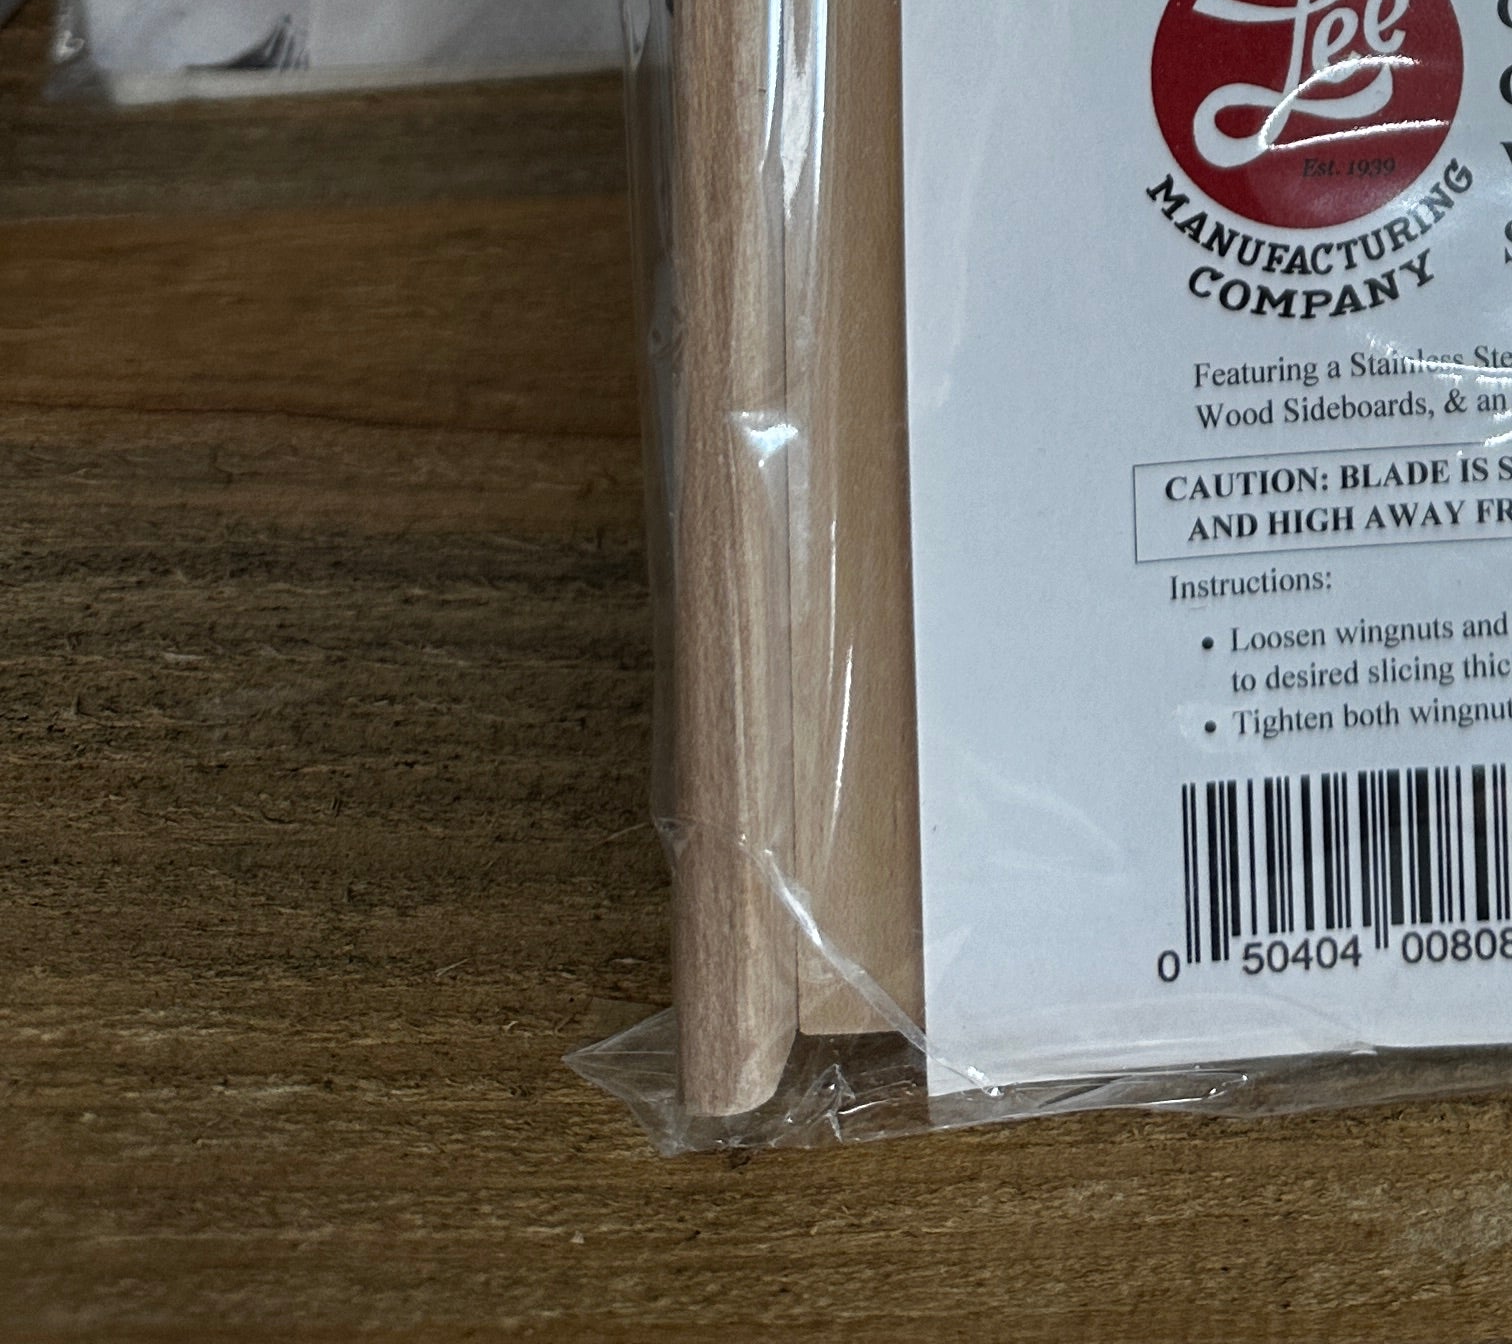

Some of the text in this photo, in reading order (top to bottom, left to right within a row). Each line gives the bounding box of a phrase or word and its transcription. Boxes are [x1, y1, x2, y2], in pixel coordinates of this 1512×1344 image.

[1302, 158, 1341, 178] Est.
[1146, 158, 1474, 275] MANUFACTURING
[1188, 249, 1435, 319] COMPANY
[1194, 355, 1320, 388] Featuring
[1327, 359, 1342, 379] a
[1196, 399, 1274, 430] Wood
[1284, 390, 1436, 424] Sideboards,
[1443, 387, 1468, 414] &
[1476, 391, 1507, 414] an
[1165, 465, 1330, 502] CAUTION:
[1340, 458, 1451, 490] BLADE
[1459, 456, 1489, 484] IS
[1188, 511, 1259, 542] AND
[1268, 505, 1355, 536] HIGH
[1365, 499, 1466, 529] AWAY
[1170, 567, 1333, 601] Instructions:
[1231, 625, 1326, 653] Loosen
[1335, 618, 1454, 649] wingnuts
[1462, 611, 1508, 637] and
[1231, 670, 1257, 694] to
[1265, 658, 1360, 691] desired
[1368, 655, 1455, 687] slicing
[1232, 707, 1334, 740] Tighten
[1343, 699, 1401, 729] both
[1157, 949, 1181, 983] 0
[1241, 934, 1363, 976] 50404
